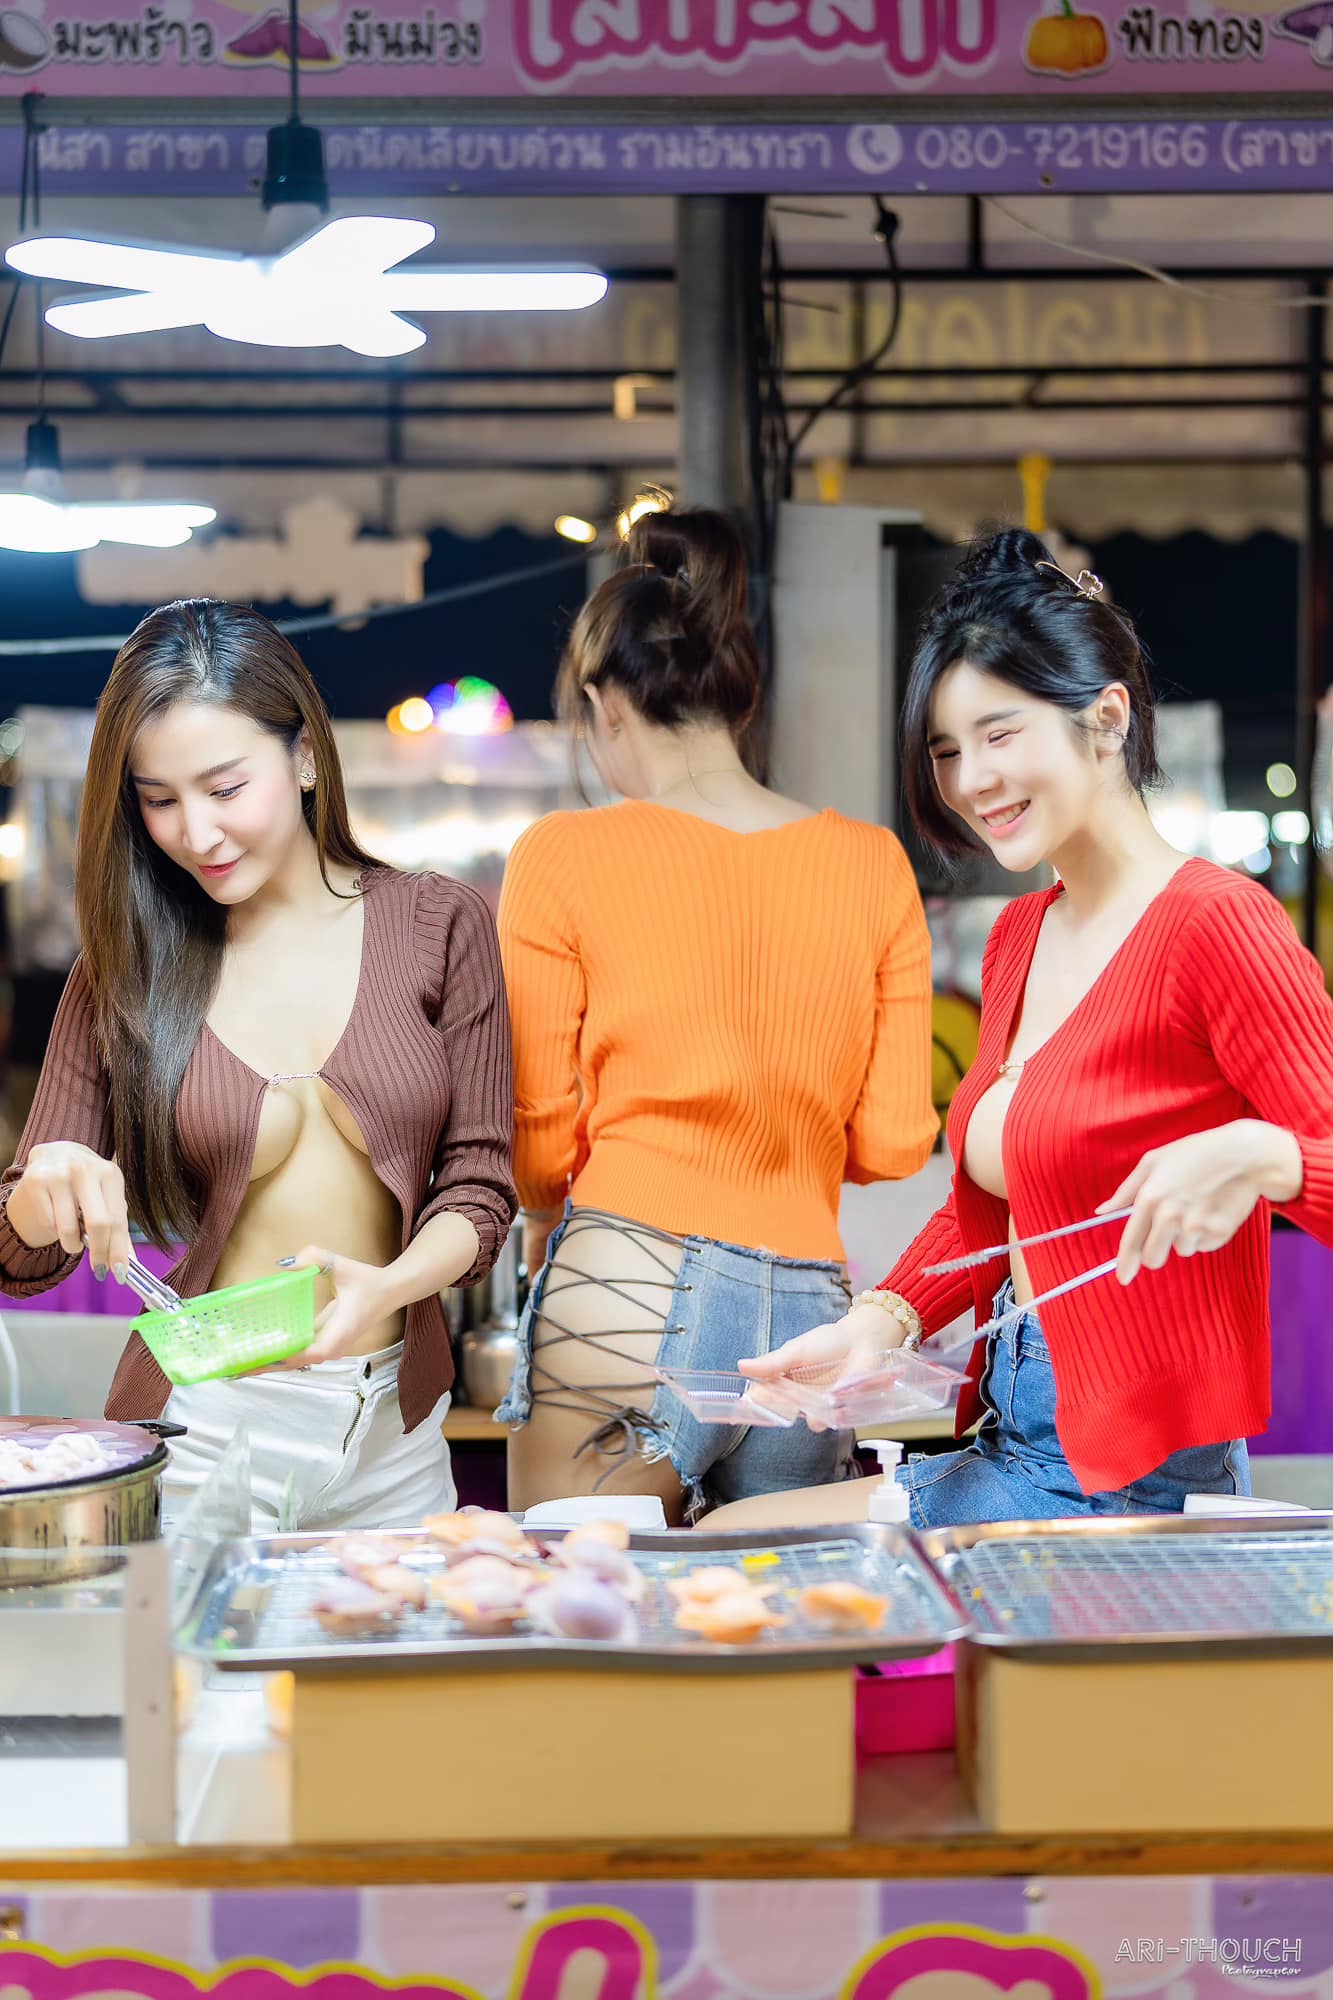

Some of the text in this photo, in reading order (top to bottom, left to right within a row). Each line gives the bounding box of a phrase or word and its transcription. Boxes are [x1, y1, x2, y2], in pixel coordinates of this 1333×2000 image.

[53, 8, 213, 62] มะพร้าว
[345, 9, 482, 59] มันม่วง
[1119, 7, 1264, 55] ฟักทอง
[915, 126, 1208, 169] 080-7219166
